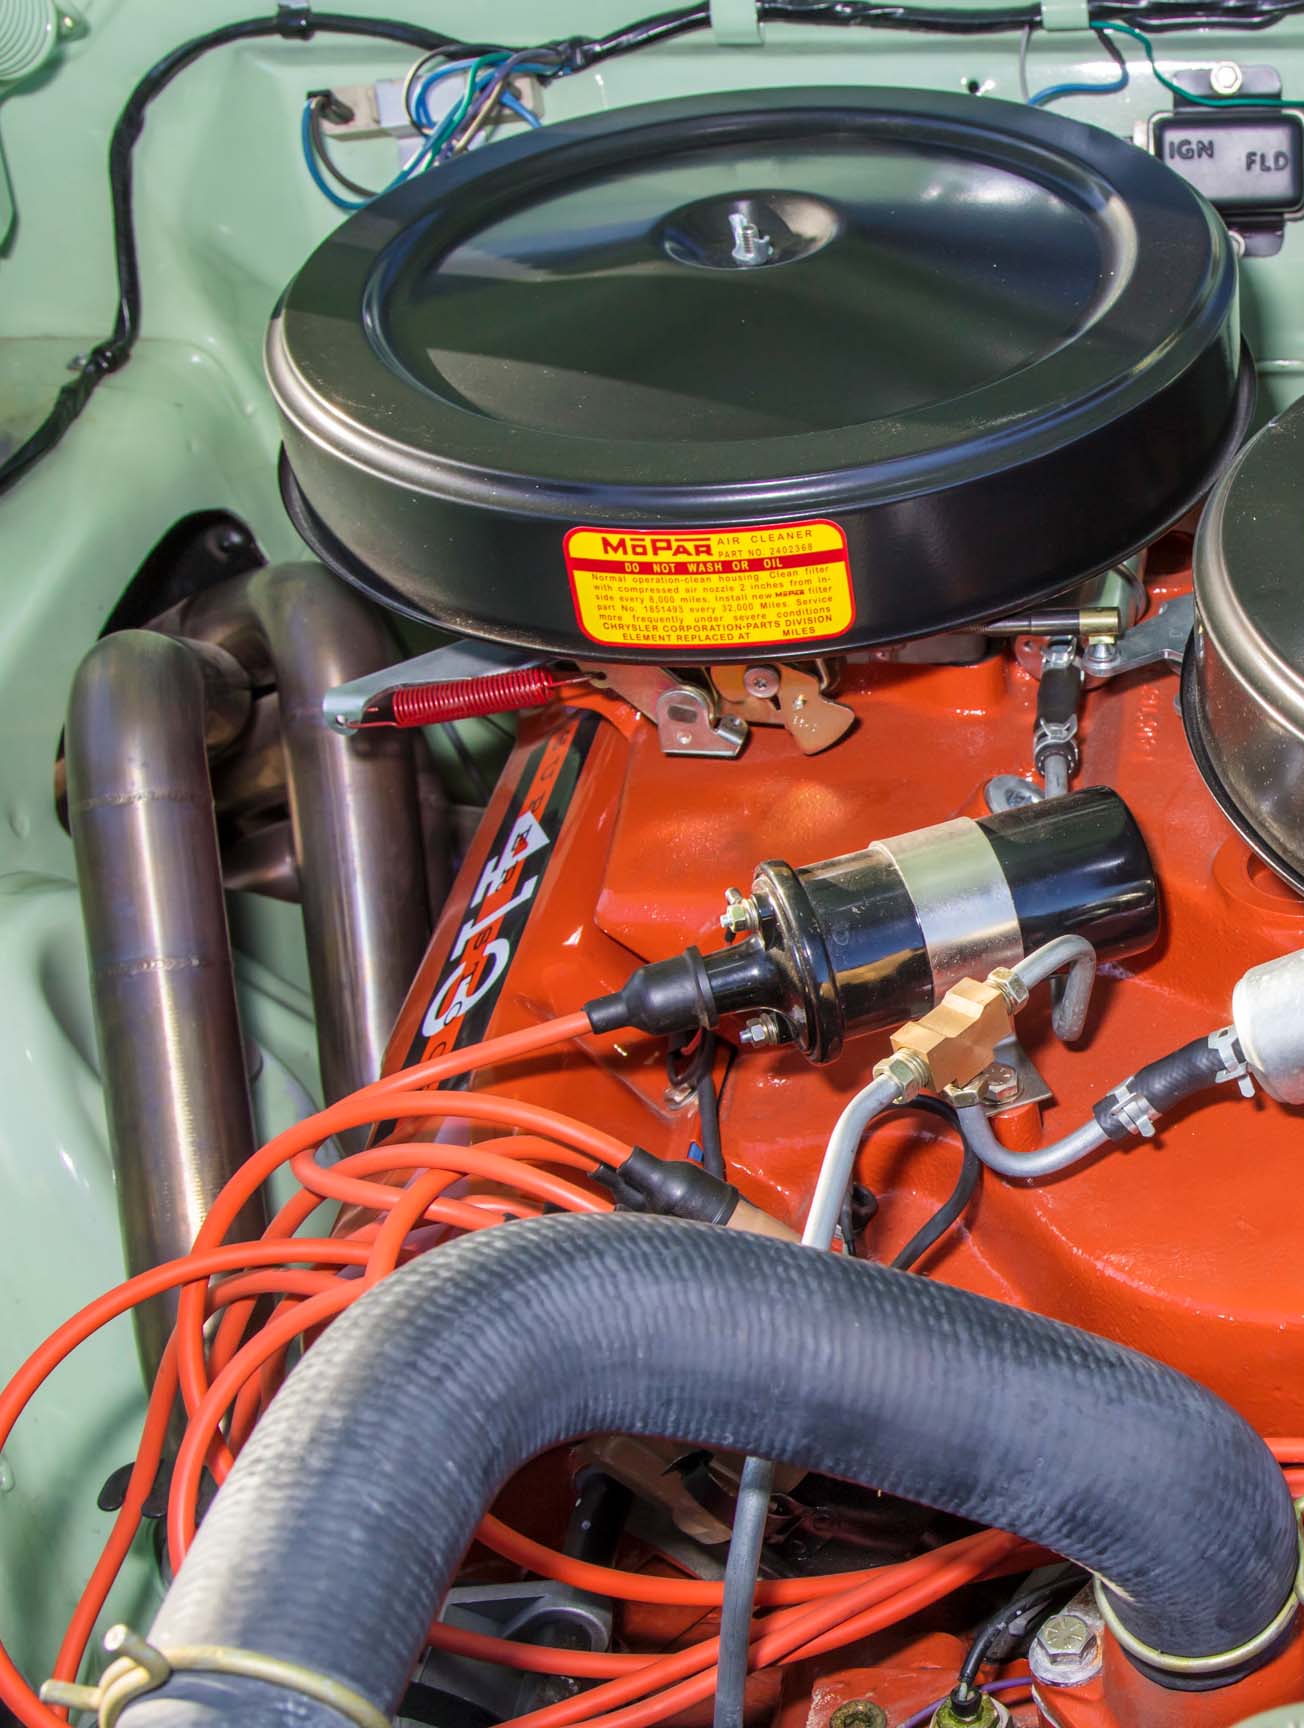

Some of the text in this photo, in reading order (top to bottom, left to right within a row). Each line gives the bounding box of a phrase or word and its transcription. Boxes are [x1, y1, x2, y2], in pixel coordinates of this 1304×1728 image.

[1168, 139, 1214, 160] IGN
[1246, 151, 1289, 172] FLD
[717, 529, 812, 546] AIR CLEANER
[718, 543, 813, 559] PART NO. 2402368
[624, 557, 783, 573] DO NOT WASH OR OIL
[591, 573, 626, 582] Normal
[632, 576, 712, 584] operation-clean
[769, 569, 798, 579] Clean
[805, 566, 829, 575] filter
[593, 583, 613, 592] with
[617, 586, 679, 594] compressed
[703, 585, 735, 593] nozzle
[740, 583, 745, 592] 2
[751, 582, 784, 590] inches
[790, 578, 812, 587] from
[620, 596, 644, 604] every
[715, 593, 748, 602] Install
[808, 585, 832, 594] filter
[597, 604, 616, 612] part
[689, 606, 716, 614] every
[722, 602, 754, 613] 32,000
[796, 596, 833, 606] Service
[602, 622, 658, 632] CHRYSLER
[784, 614, 832, 627] DIVISION
[632, 614, 684, 624] frequently
[694, 615, 723, 623] under
[733, 612, 767, 621] severe
[776, 606, 831, 618] conditions
[623, 627, 816, 642] ELEMENT REPLACED AT MILES
[421, 810, 550, 1037] 413
